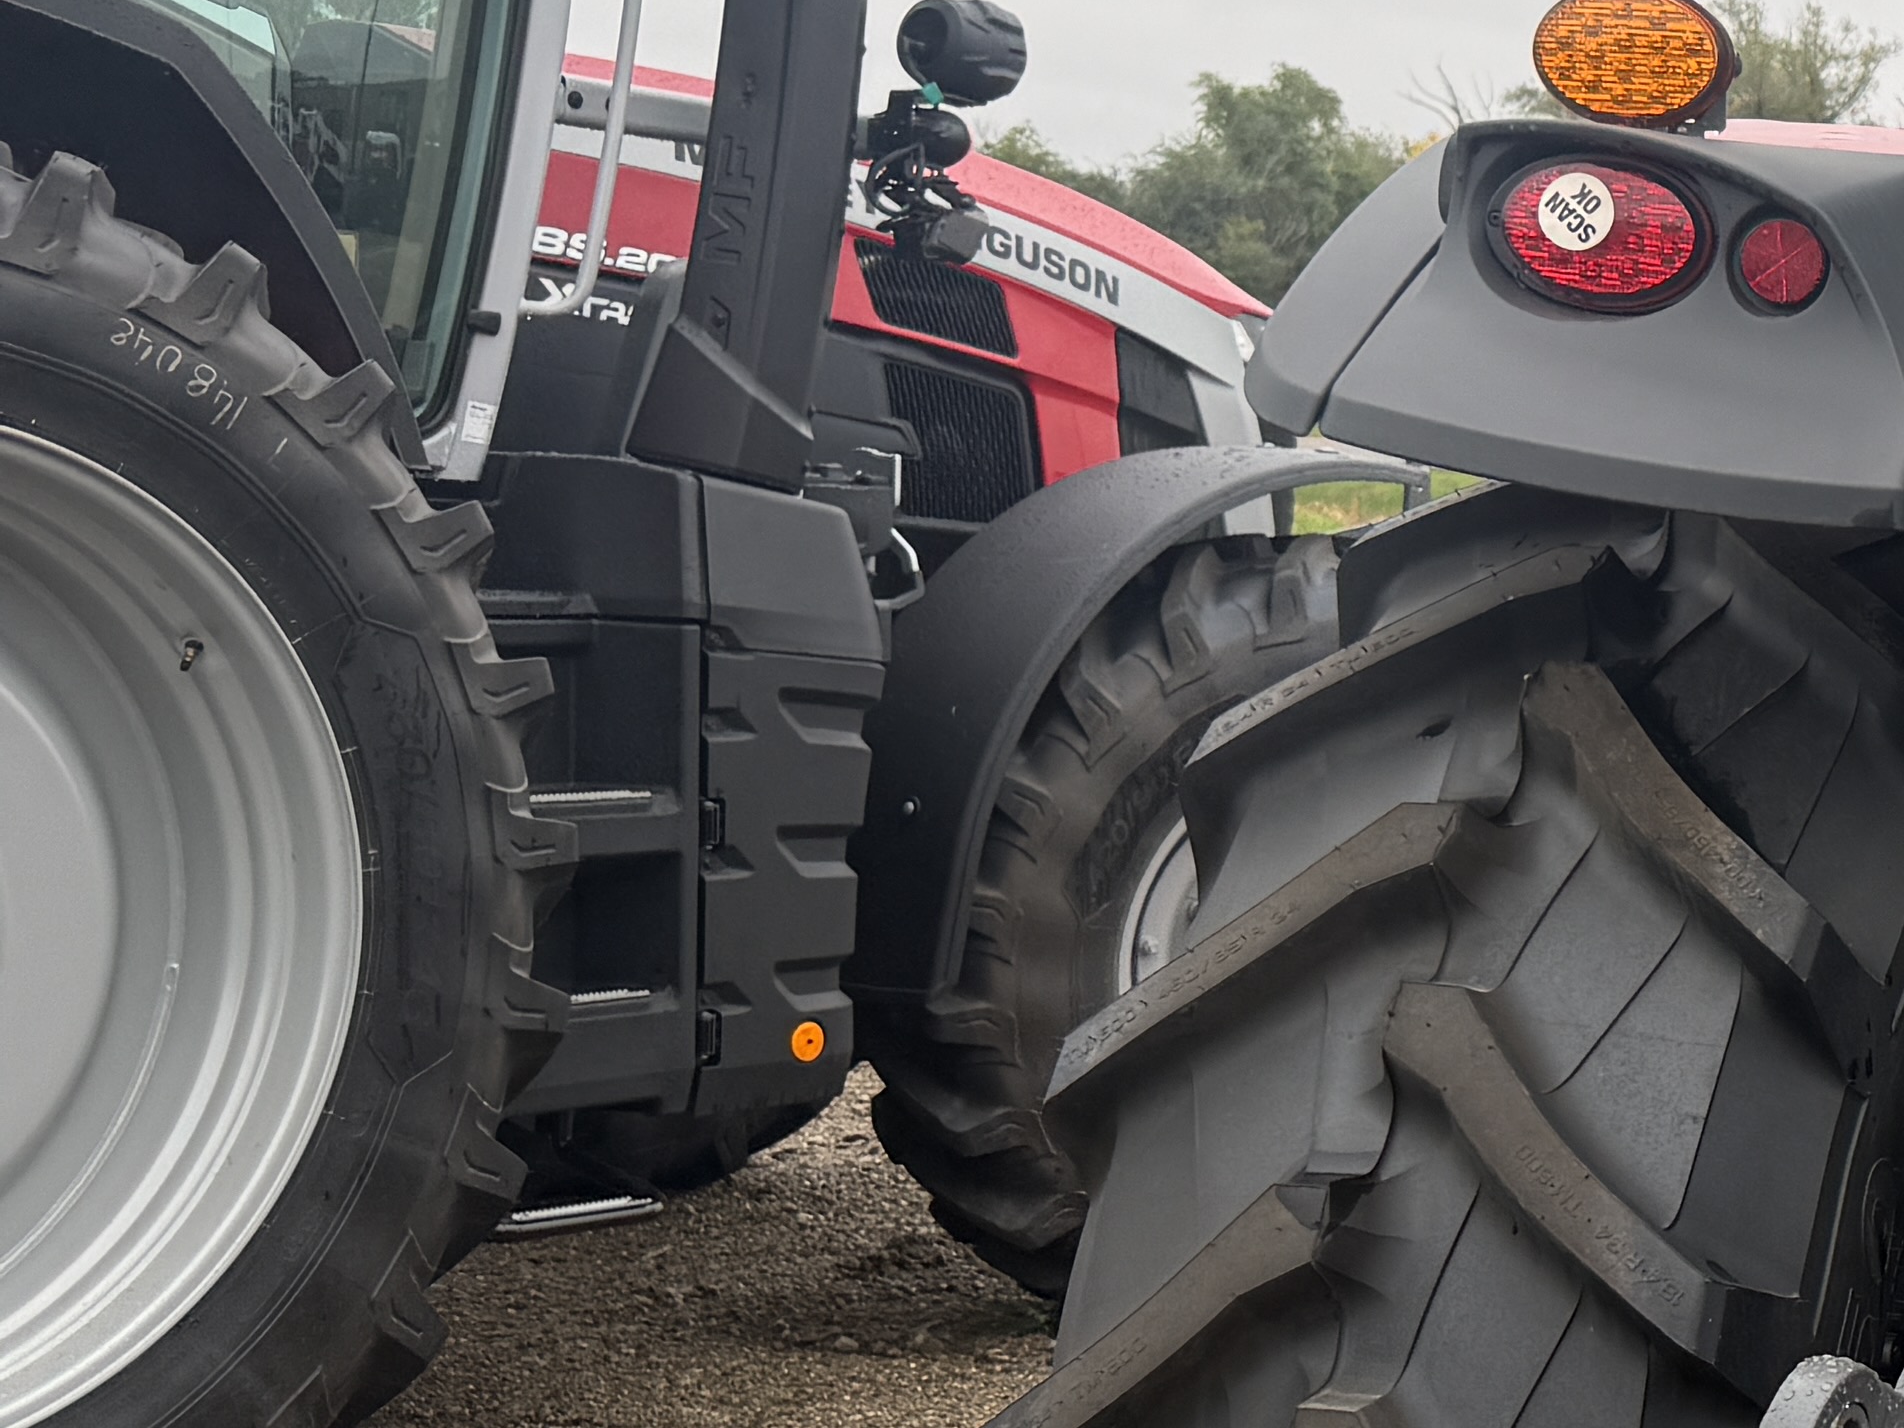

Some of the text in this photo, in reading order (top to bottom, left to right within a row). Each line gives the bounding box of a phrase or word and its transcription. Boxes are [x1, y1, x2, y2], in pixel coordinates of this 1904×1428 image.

[1544, 191, 1597, 243] SCAN
[1570, 182, 1602, 215] OK
[980, 225, 1120, 307] GUSON
